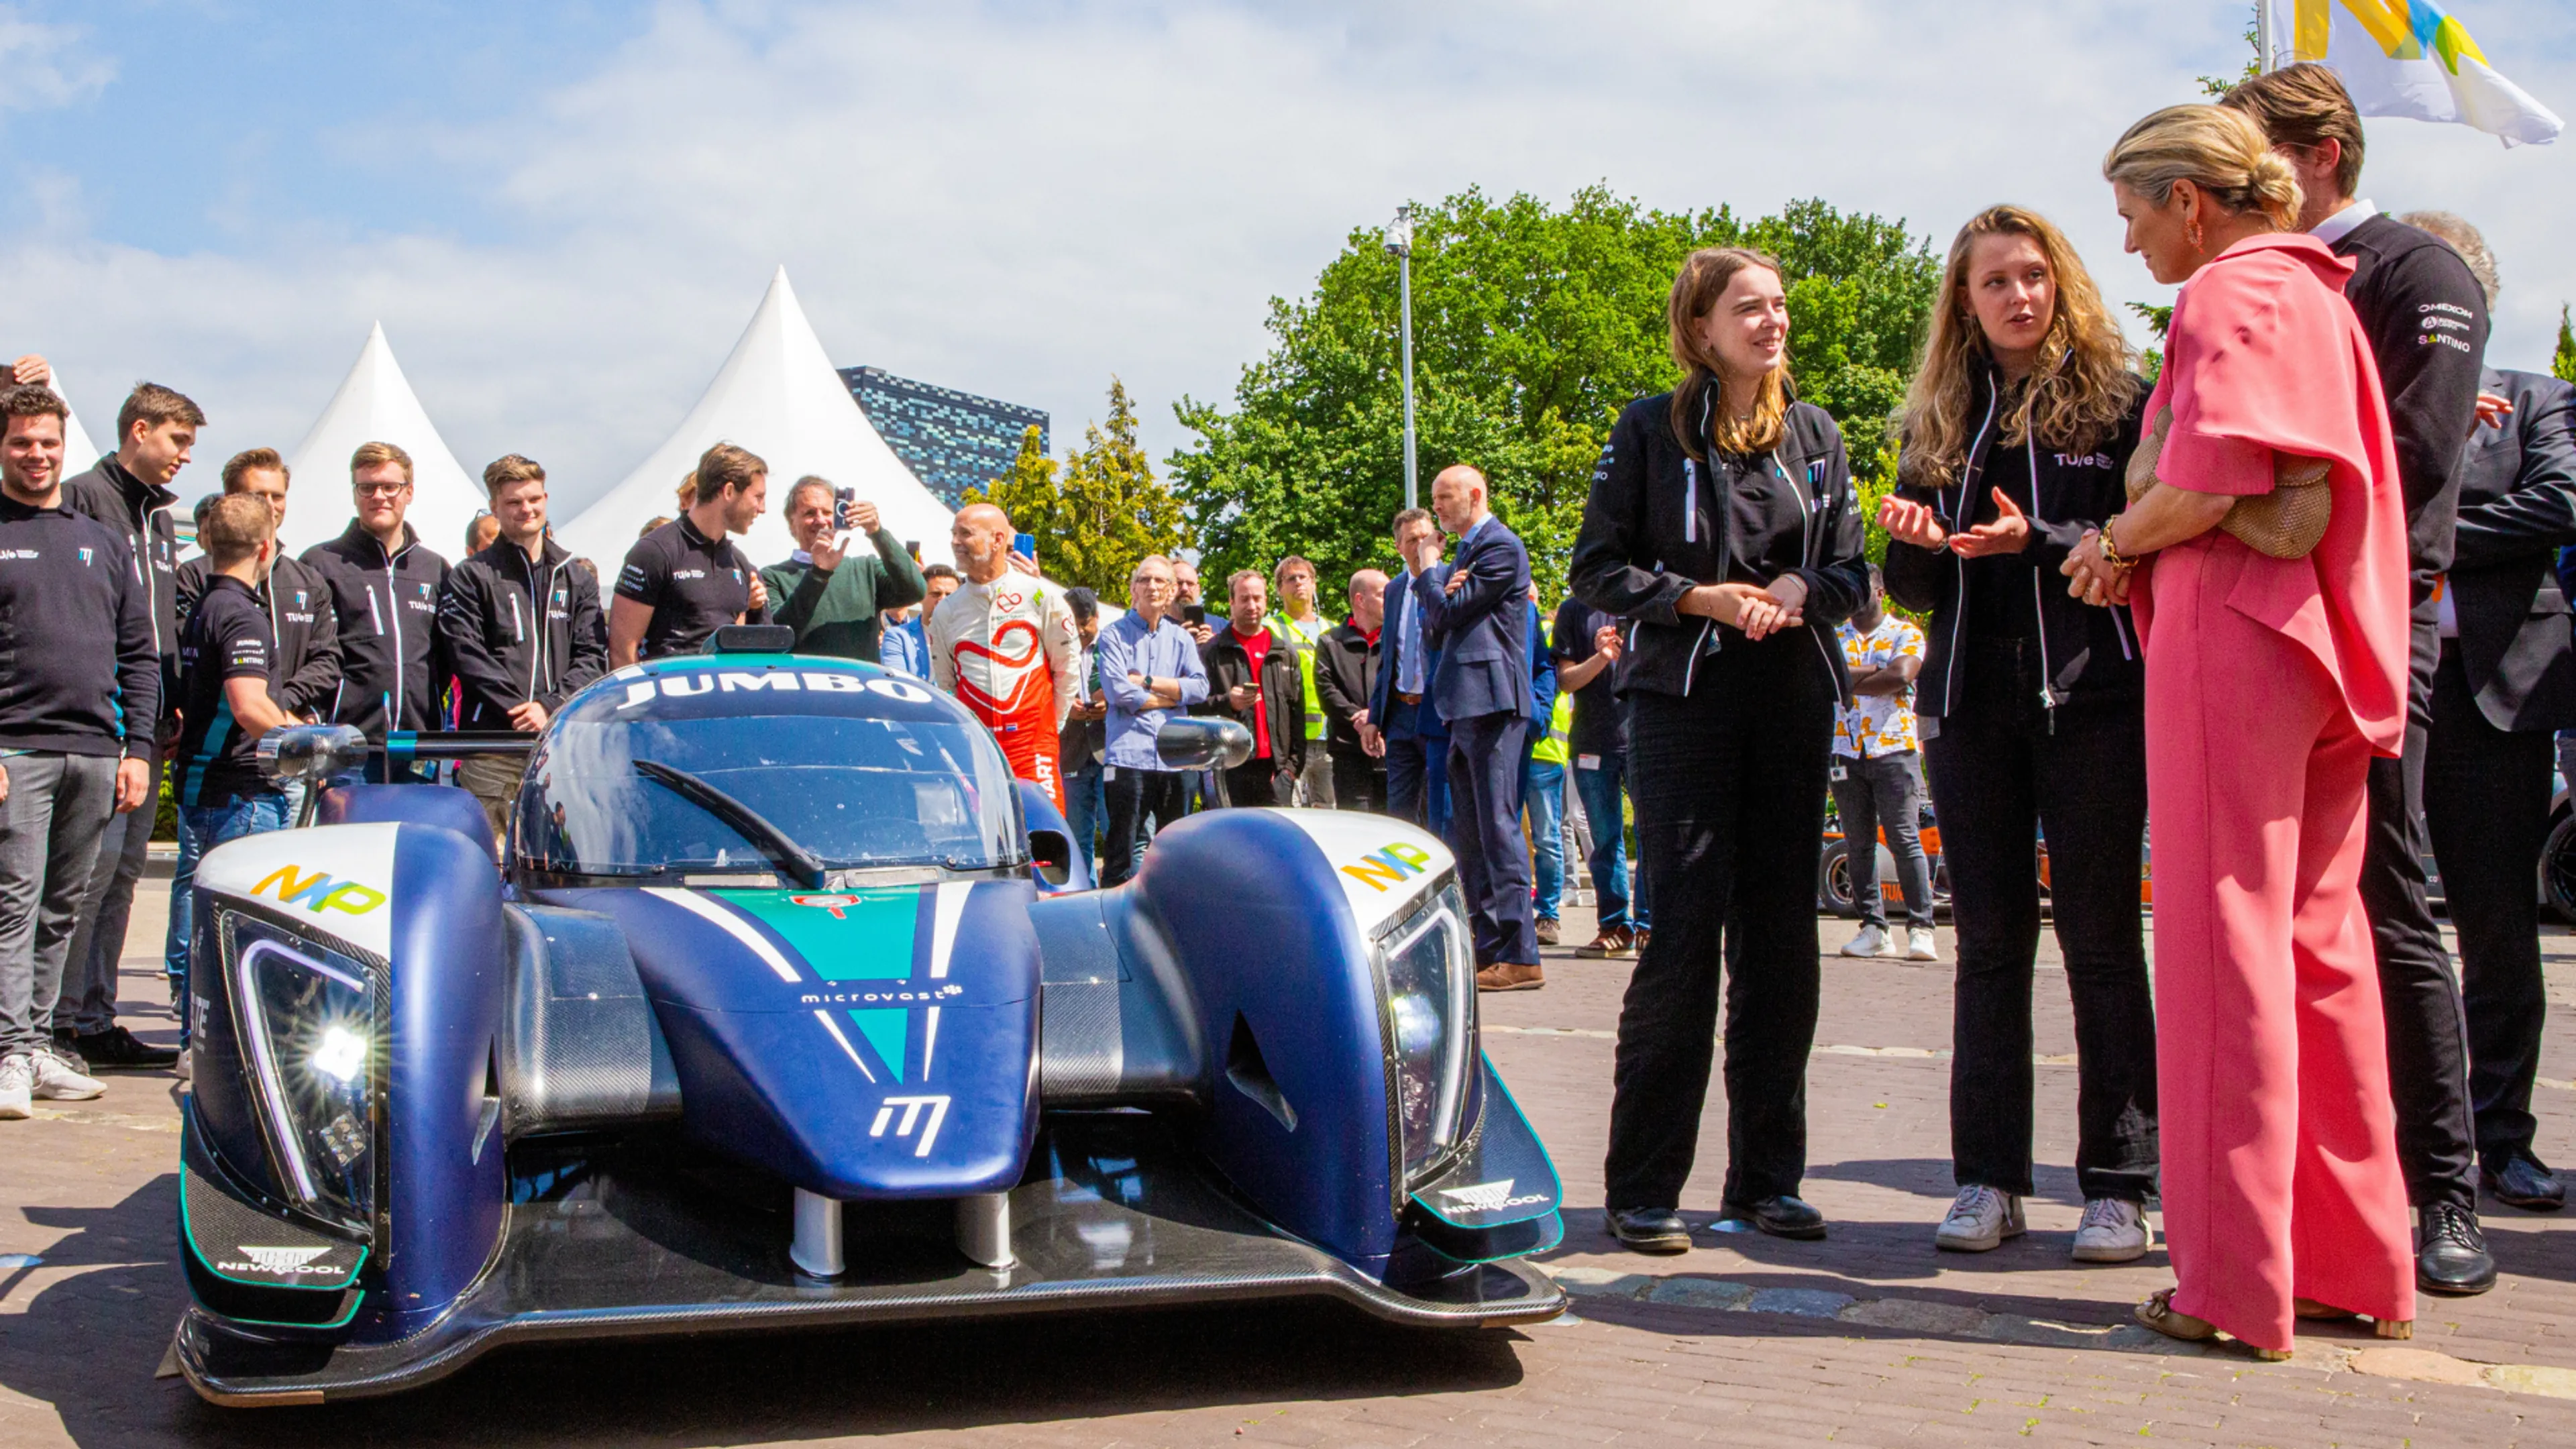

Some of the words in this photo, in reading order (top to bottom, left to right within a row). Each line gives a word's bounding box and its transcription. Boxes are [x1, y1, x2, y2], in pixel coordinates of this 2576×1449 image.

[2418, 303, 2473, 319] OMEXOM
[2418, 333, 2470, 353] SANTINO
[2054, 453, 2094, 468] TU/e
[616, 672, 932, 710] JUMBO
[1340, 841, 1431, 893] NXP
[249, 863, 387, 916] NXP
[801, 989, 946, 1004] microvast
